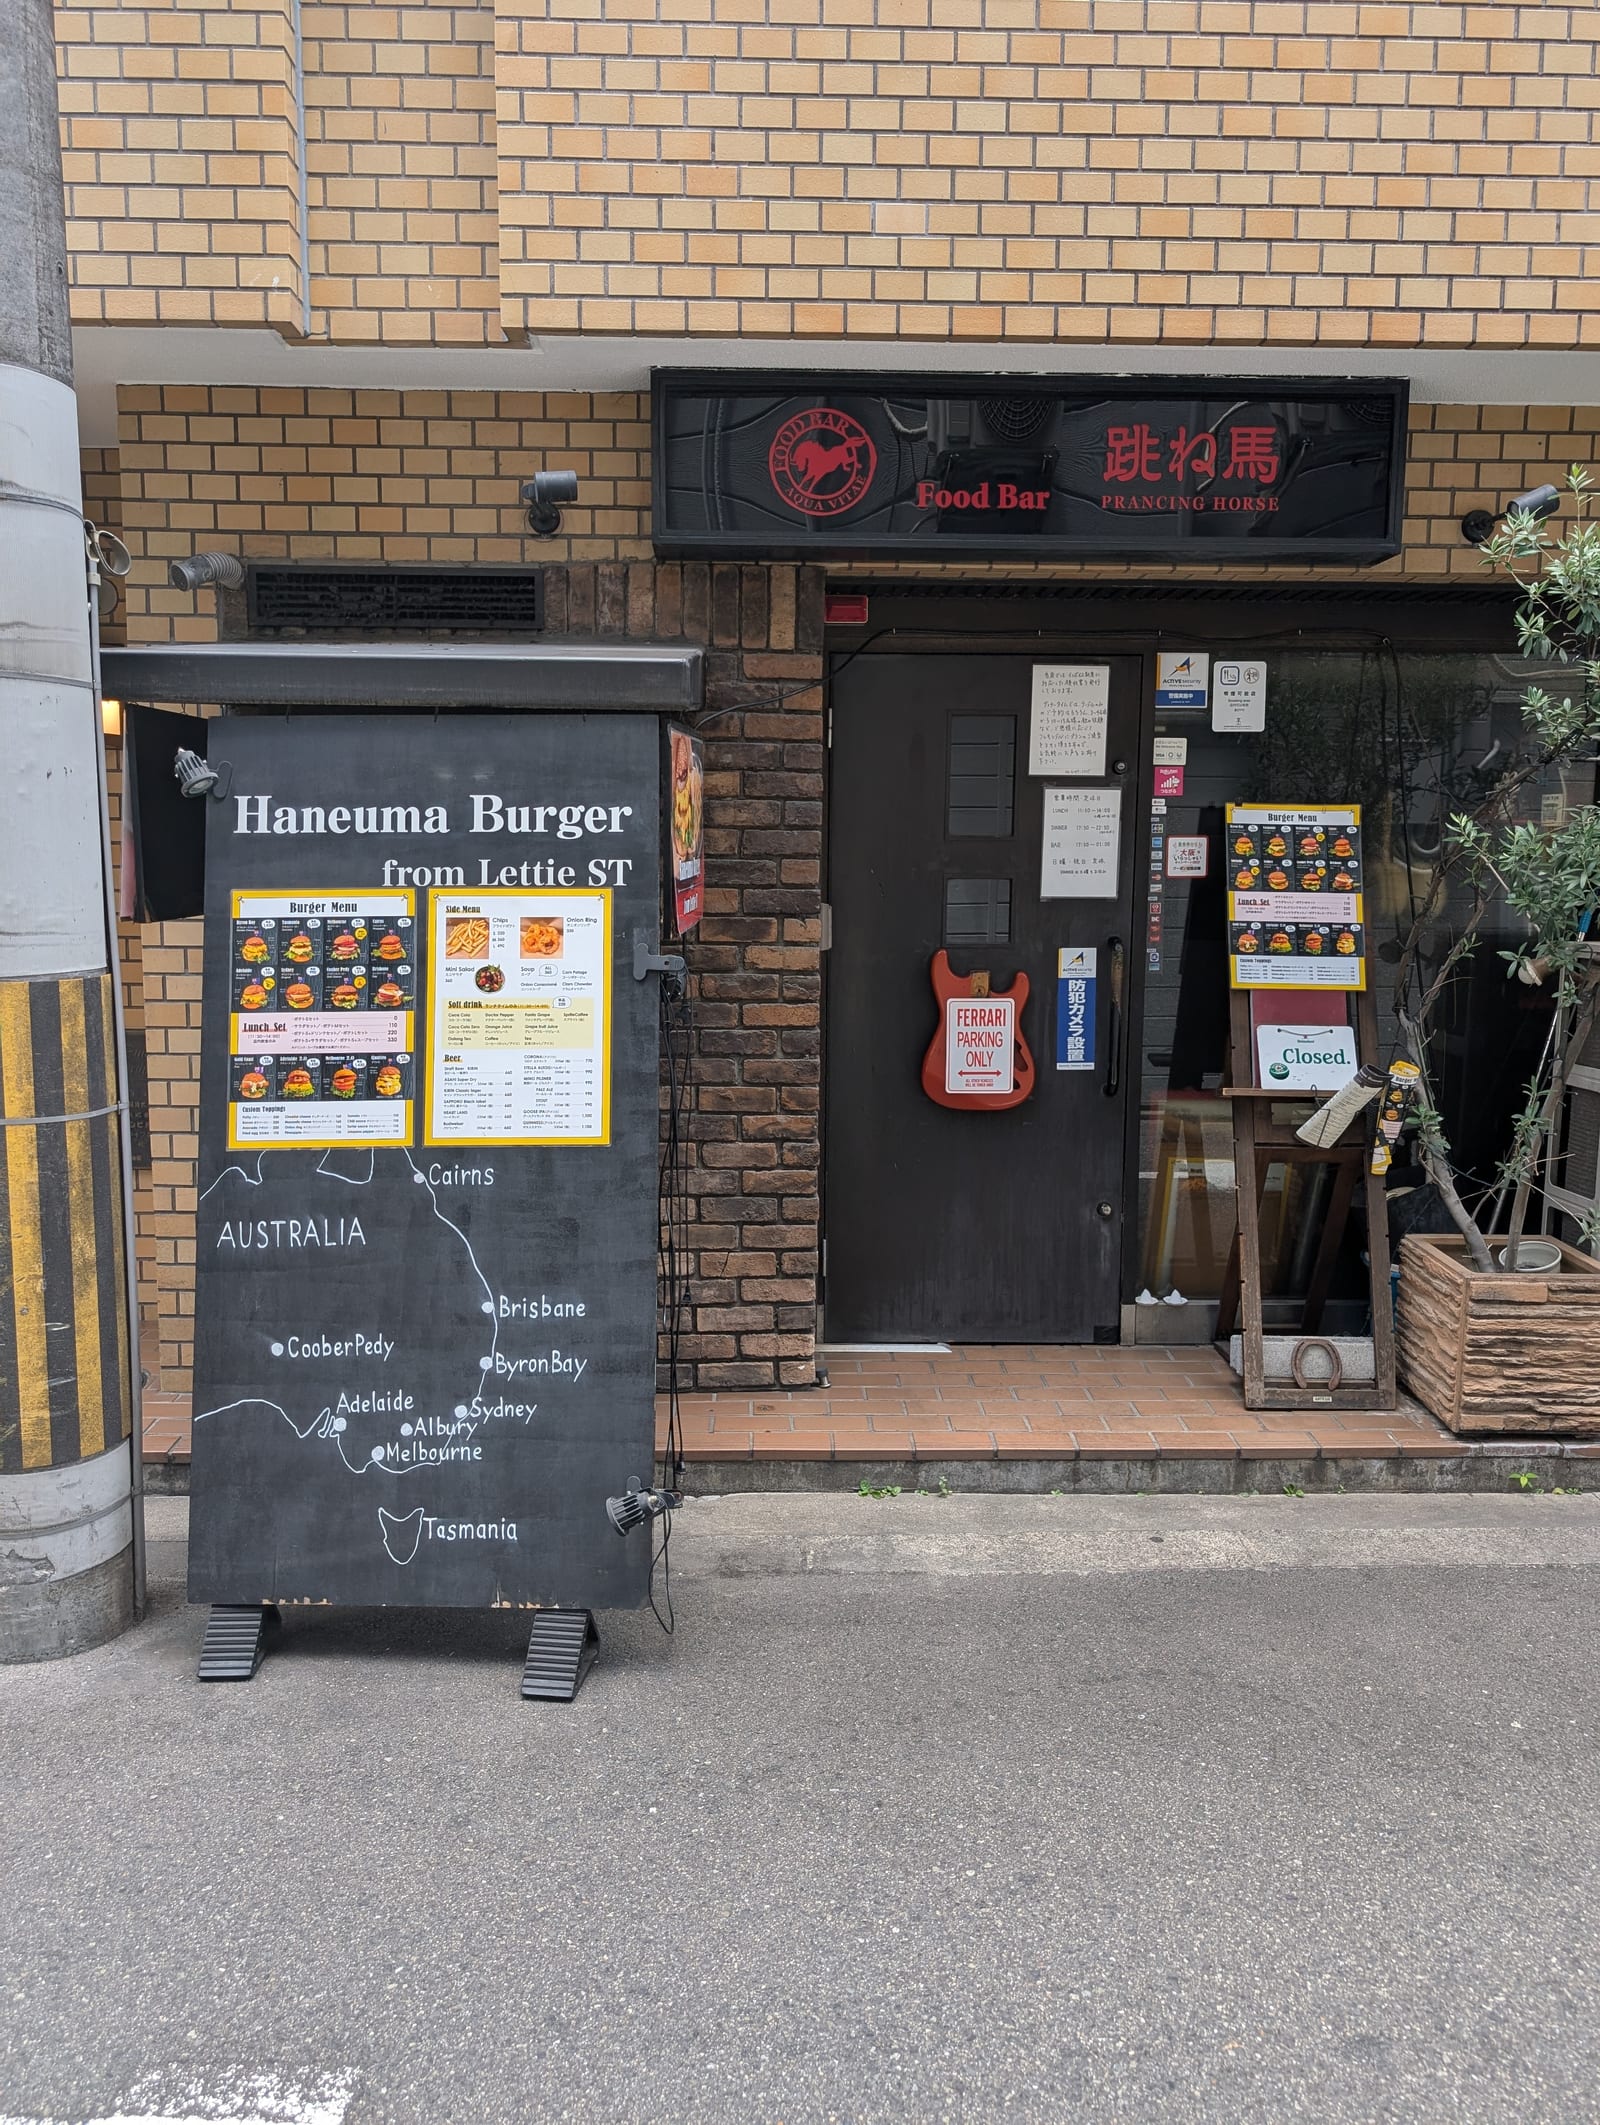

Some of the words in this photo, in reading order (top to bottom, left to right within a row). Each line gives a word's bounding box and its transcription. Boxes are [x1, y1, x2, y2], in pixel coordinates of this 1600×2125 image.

[809, 412, 850, 434] BAR
[1103, 424, 1280, 483] 跳ね馬
[784, 486, 825, 511] AQUA
[916, 483, 990, 509] Food
[997, 484, 1050, 510] Bar
[1101, 495, 1205, 512] PRANCING
[1213, 496, 1279, 512] HORSE
[233, 795, 450, 834] Haneuma
[469, 794, 632, 840] Burger
[1267, 813, 1294, 823] Burger
[1297, 813, 1318, 822] Menu
[1180, 848, 1195, 856] 大阪
[382, 859, 466, 887] from
[478, 858, 575, 887] Lettie
[588, 859, 632, 887] ST
[289, 902, 327, 914] Burger
[331, 901, 358, 913] Menu
[445, 905, 461, 914] Side
[462, 905, 481, 914] Menu
[1237, 898, 1258, 906] Lunch
[1260, 898, 1271, 906] Set
[520, 966, 535, 974] Soup
[448, 1000, 462, 1009] Soft
[463, 1000, 482, 1009] drink
[243, 1022, 270, 1032] Lunch
[273, 1022, 287, 1032] Set
[957, 1008, 1007, 1027] FERRARI
[1067, 979, 1087, 1062] 防犯カメラ設置
[957, 1031, 1003, 1048] PARKING
[444, 1054, 461, 1062] Beer
[966, 1051, 994, 1067] ONLY
[1282, 1048, 1351, 1065] Closed.
[429, 1163, 494, 1187] Cairns
[217, 1217, 366, 1249] AUSTRALIA
[499, 1294, 586, 1318] Brisbane
[336, 1389, 414, 1413] Adelaide
[471, 1397, 538, 1429] Sydney
[414, 1417, 478, 1440] Albury
[386, 1442, 482, 1462] Melbourne
[424, 1517, 518, 1541] Tasmania
